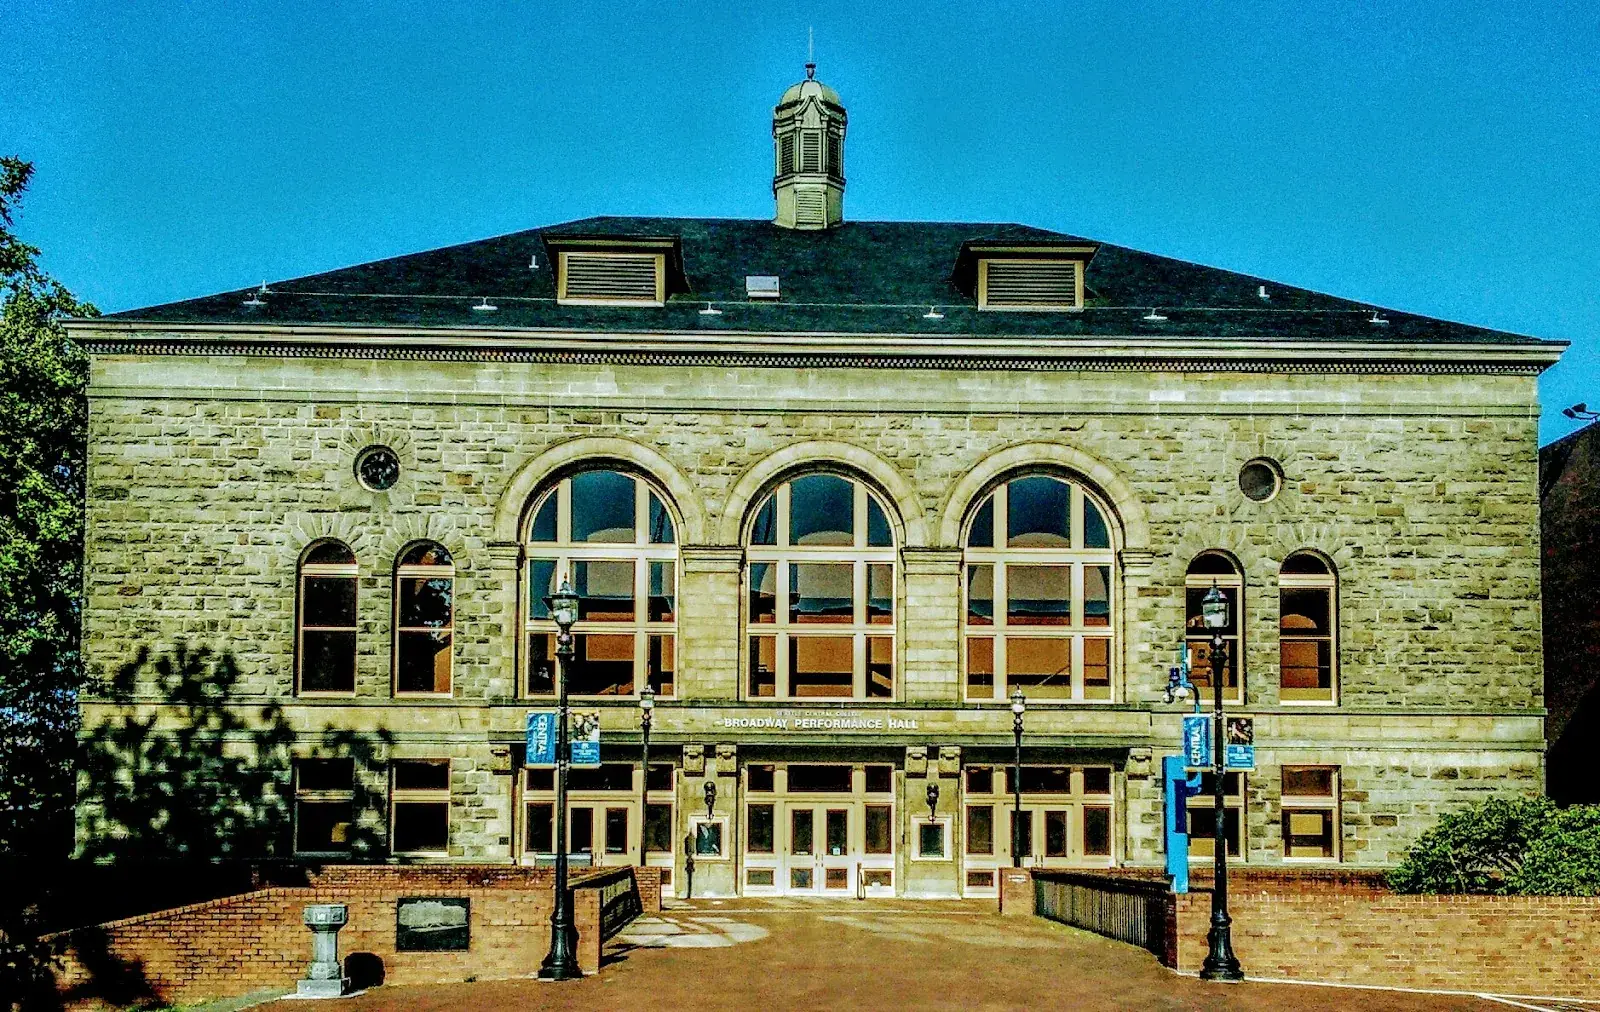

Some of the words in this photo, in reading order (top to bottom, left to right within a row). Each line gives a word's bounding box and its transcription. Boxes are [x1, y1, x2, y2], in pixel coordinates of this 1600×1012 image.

[538, 714, 548, 755] CENTRAL
[724, 718, 788, 728] BROADWAY
[794, 719, 883, 729] PERFORMANCE
[888, 718, 919, 729] HALL
[1191, 726, 1200, 765] CENTRAL
